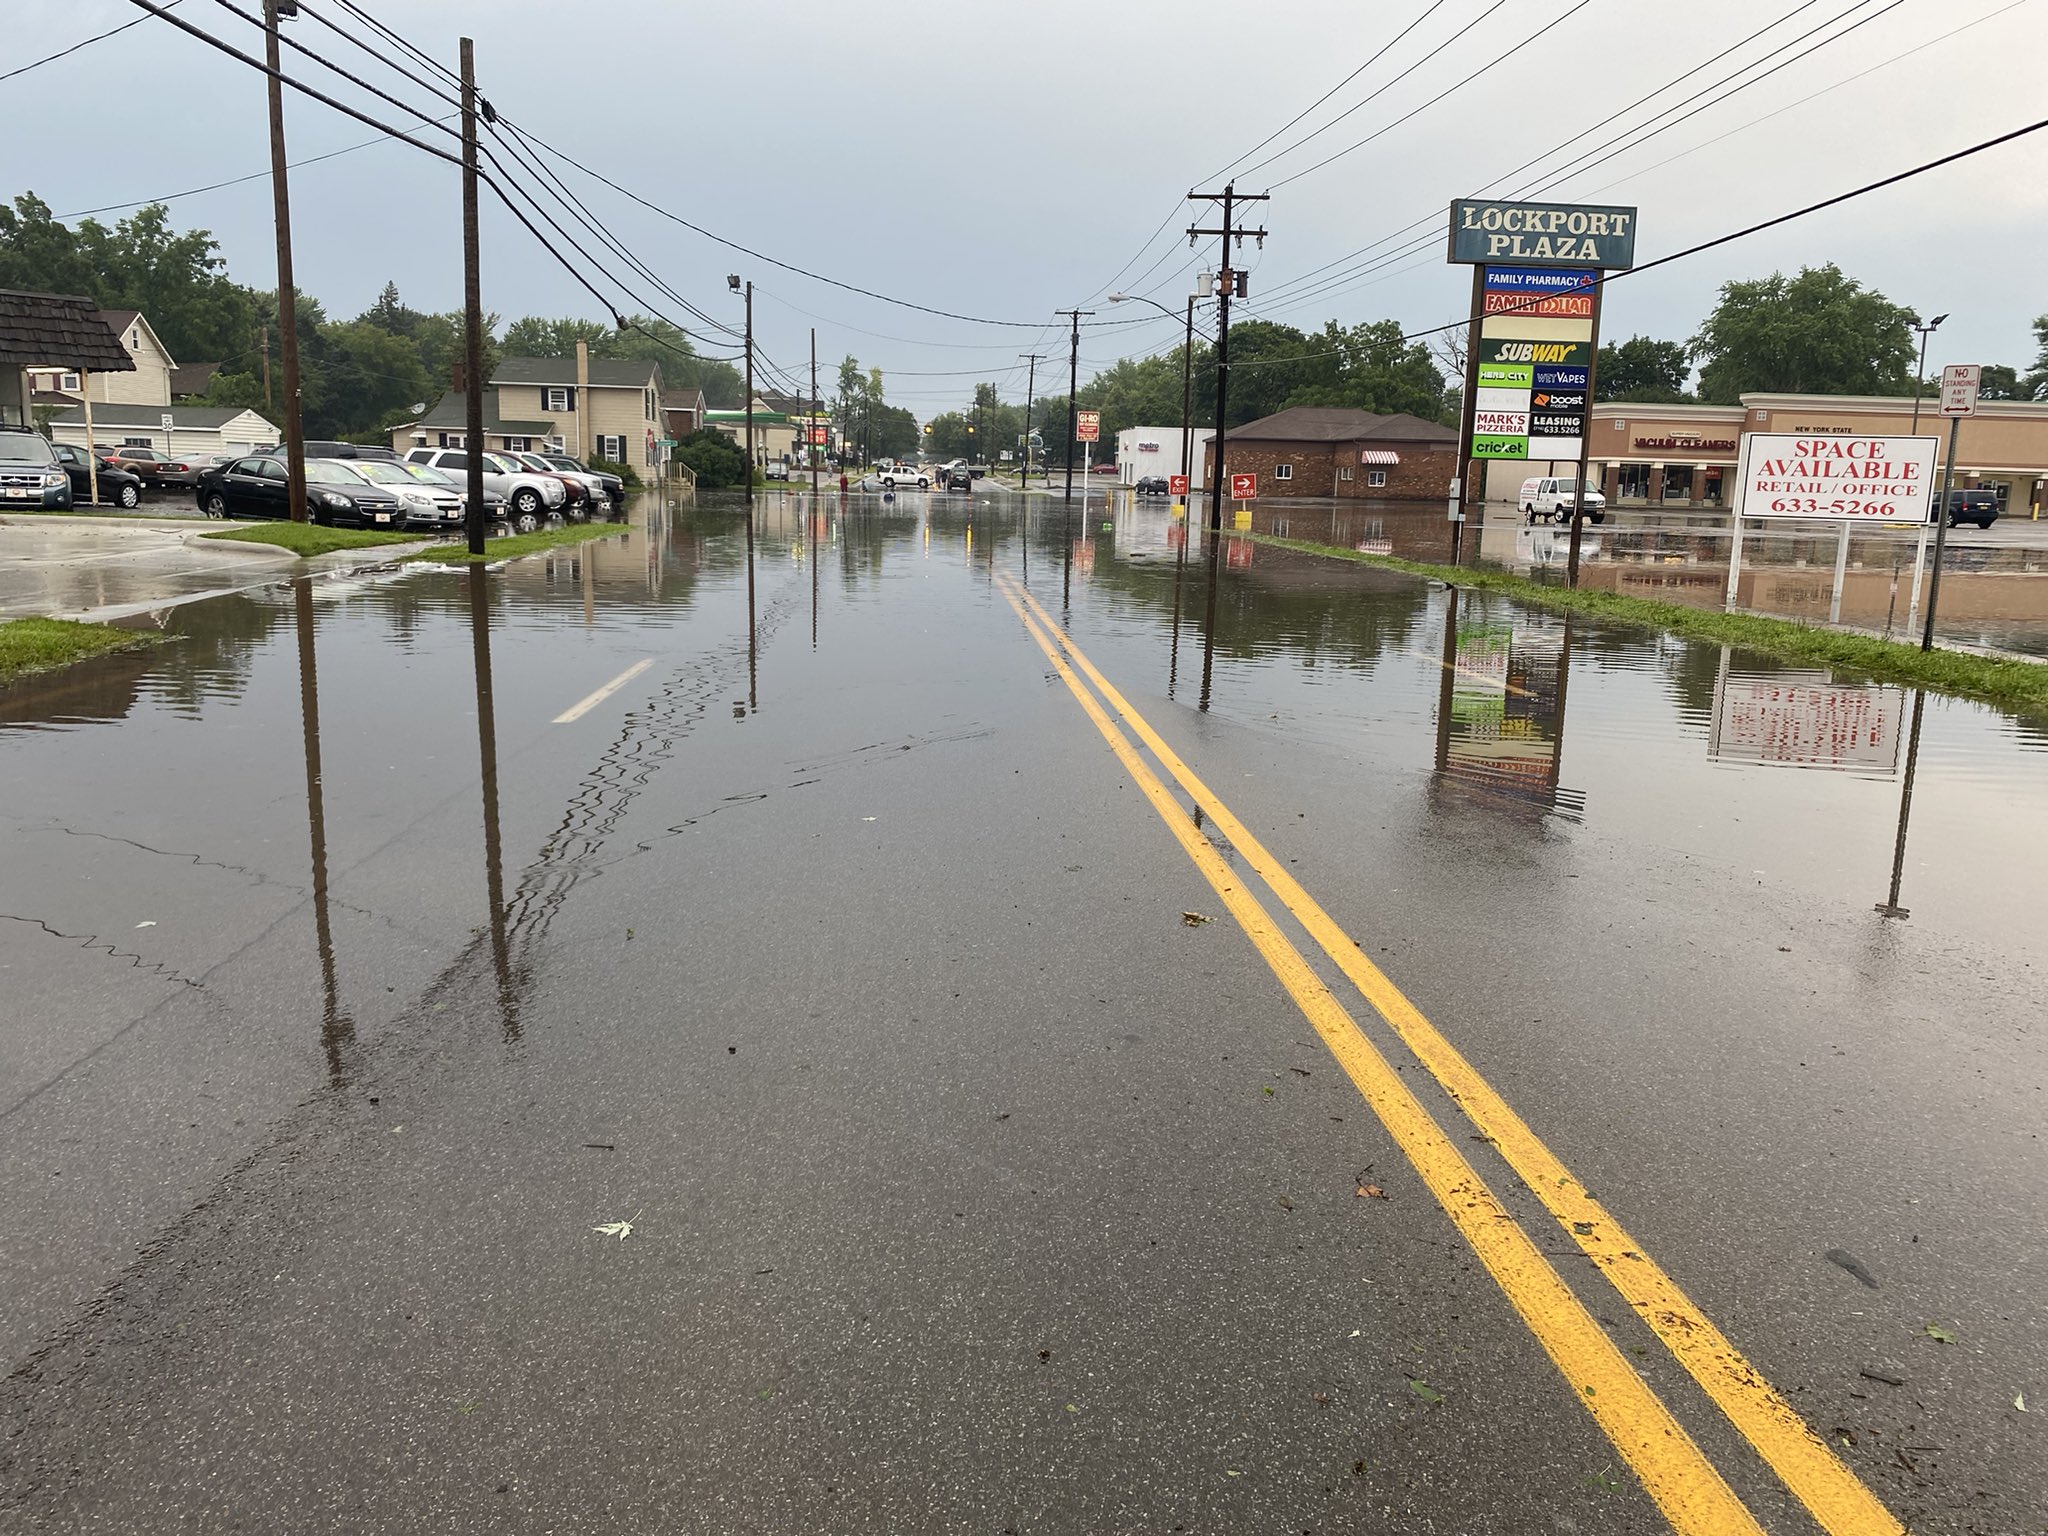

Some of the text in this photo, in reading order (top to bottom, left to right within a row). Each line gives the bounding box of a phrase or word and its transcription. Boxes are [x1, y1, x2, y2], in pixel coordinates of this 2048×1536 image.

[1462, 207, 1629, 236] LOCKPORT
[1487, 234, 1600, 260] PLAZA
[1488, 273, 1579, 286] FAMILY PHARMACY
[1486, 294, 1591, 315] FAMILY DOLLAR
[1494, 343, 1577, 362] SUBWAY
[1480, 371, 1529, 381] HERB CITY
[1954, 368, 1969, 378] NO
[1945, 379, 1976, 387] STANDING
[1550, 394, 1583, 405] boost
[1477, 414, 1525, 425] MARK'S
[1533, 416, 1580, 426] LEASING
[1476, 424, 1524, 433] PIZZERIA
[1476, 441, 1523, 453] cricket
[1794, 440, 1885, 459] SPACE
[1757, 459, 1920, 480] AVAILABLE
[1234, 489, 1255, 497] ENTER
[1756, 481, 1829, 494] RETAIL
[1842, 483, 1918, 497] OFFICE
[1771, 497, 1896, 516] 633-5266
